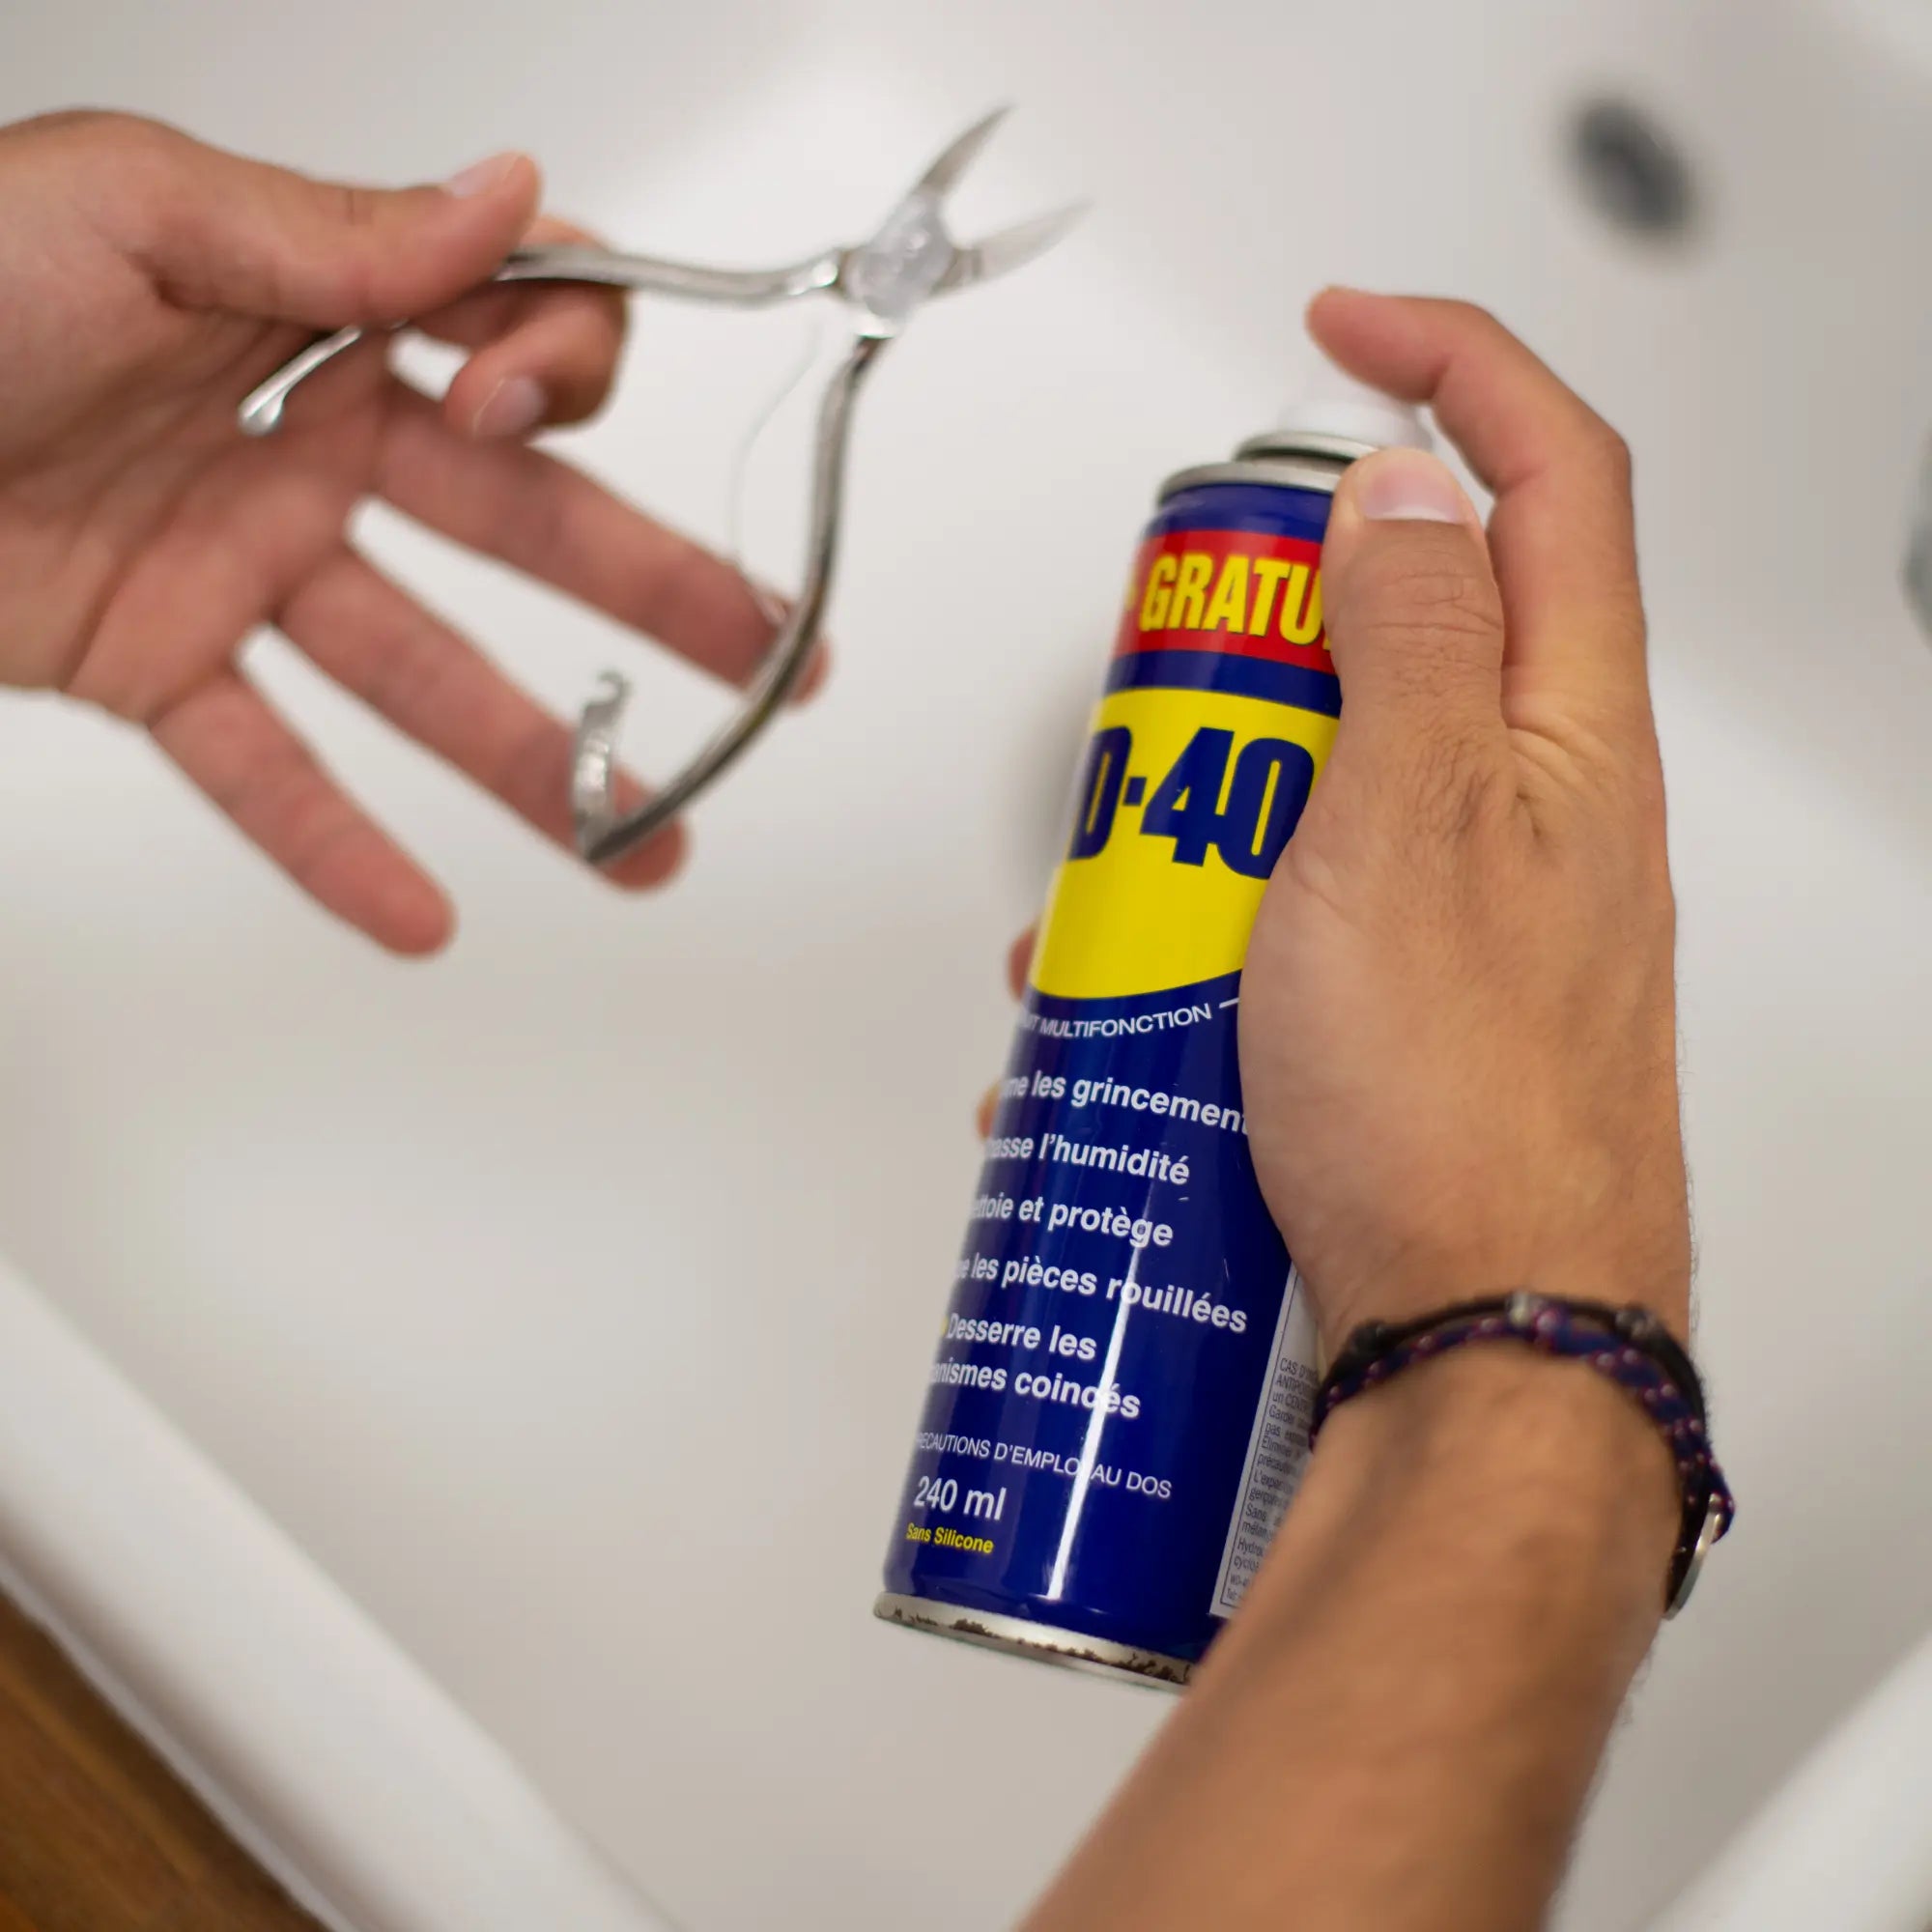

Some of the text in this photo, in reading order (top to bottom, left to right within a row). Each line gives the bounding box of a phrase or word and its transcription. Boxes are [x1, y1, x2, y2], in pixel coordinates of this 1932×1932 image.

[1139, 553, 1331, 650] GRATU
[1039, 1003, 1212, 1038] MULTIFONCTION
[1031, 1069, 1066, 1098] les
[1037, 1132, 1190, 1184] l'humidité
[1018, 1196, 1044, 1222] et
[1047, 1205, 1174, 1248] protège
[971, 1252, 999, 1280] les
[1001, 1255, 1098, 1296] pièces
[1105, 1277, 1249, 1334] rouillées
[947, 1312, 1097, 1360] Desserre les
[933, 1356, 1008, 1391] anismes
[993, 1442, 1086, 1477] D'EMPLO
[1090, 1463, 1122, 1486] AU
[1125, 1471, 1172, 1498] DOS
[913, 1475, 1007, 1520] 240 ml
[906, 1522, 994, 1553] Sans Silicone
